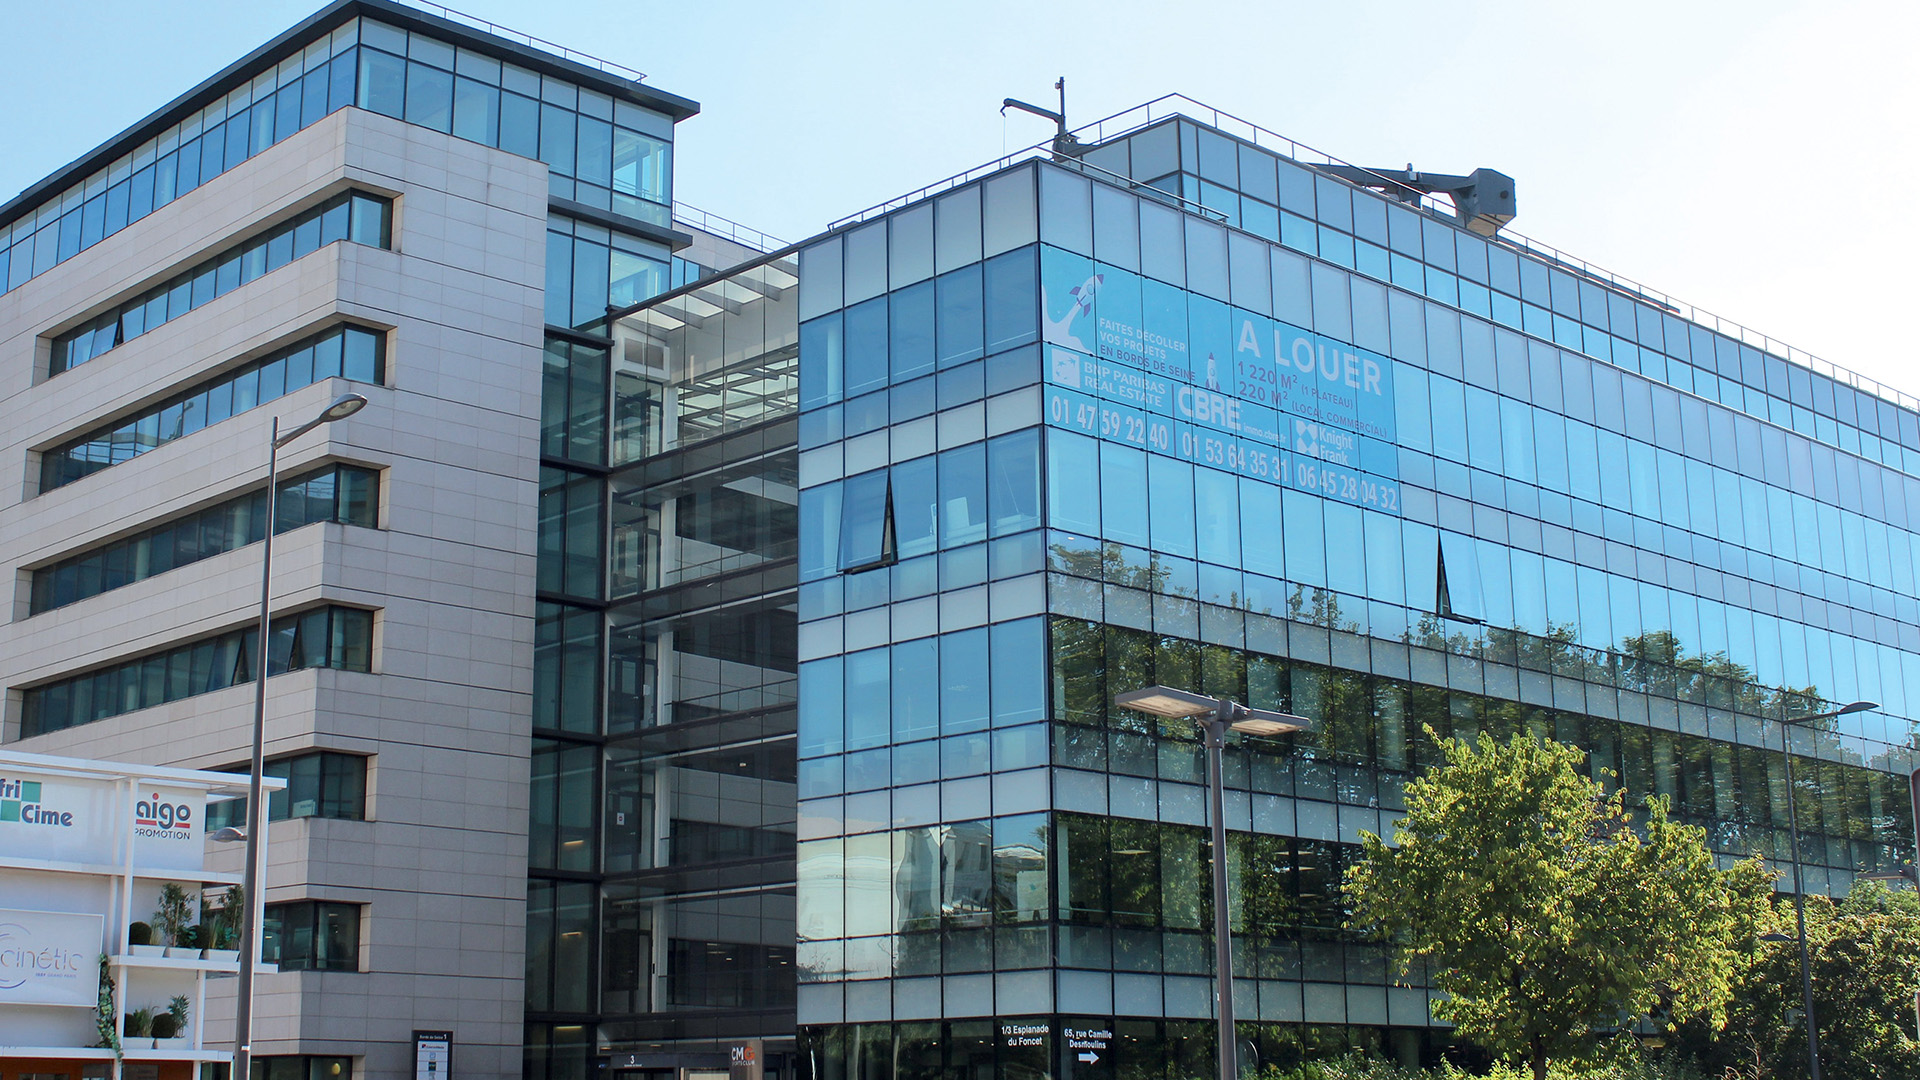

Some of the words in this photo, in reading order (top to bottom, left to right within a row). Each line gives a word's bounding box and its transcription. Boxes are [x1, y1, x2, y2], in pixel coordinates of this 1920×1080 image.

[1100, 317, 1134, 337] FAITES
[1136, 326, 1186, 353] DÉCOLLER
[1100, 331, 1121, 346] VOS
[1123, 337, 1166, 360] PROJETS
[1100, 344, 1114, 357] EN
[1117, 349, 1150, 368] BORDS
[1153, 360, 1166, 373] DE
[1168, 365, 1197, 382] SEINE
[1237, 319, 1262, 358] A
[1273, 329, 1383, 397] LOUER
[1084, 362, 1111, 378] BNP
[1113, 370, 1166, 394] PARIBAS
[1084, 376, 1116, 395] REAL
[1119, 385, 1162, 408] ESTATE
[1249, 365, 1276, 385] 220
[1311, 387, 1354, 410] PLATEAU)
[1051, 395, 1070, 425] 01
[1076, 403, 1096, 430] 47
[1102, 409, 1120, 437] 59
[1125, 415, 1145, 444] 22
[1149, 423, 1169, 451] 40
[1178, 386, 1241, 431] CBRE
[1239, 381, 1266, 402] 220
[1291, 400, 1324, 420] (LOCAL
[1326, 412, 1388, 439] COMMERCIAL)
[1319, 426, 1354, 450] Knight
[1182, 431, 1200, 459] 01
[1205, 438, 1224, 465] 53
[1228, 444, 1246, 471] 64
[1250, 450, 1268, 477] 35
[1271, 456, 1289, 482] 31
[1320, 444, 1349, 466] Frank
[1298, 463, 1317, 489] 06
[1320, 469, 1337, 495] 45
[1340, 475, 1358, 500] 28
[1361, 480, 1378, 506] 04
[1380, 485, 1398, 511] 32
[22, 804, 73, 827] Cime
[136, 792, 191, 829] aigo
[1, 947, 83, 971] cinétic
[1001, 1026, 1012, 1035] 1/3
[1013, 1024, 1049, 1036] Esplanade
[1008, 1037, 1017, 1046] du
[1018, 1037, 1043, 1046] Foncet
[1064, 1028, 1075, 1039] 65,
[1076, 1030, 1087, 1039] rue
[1088, 1029, 1113, 1039] Camille
[1069, 1039, 1107, 1049] Desmoulins
[630, 1054, 635, 1064] 3
[731, 1046, 755, 1061] CMG
